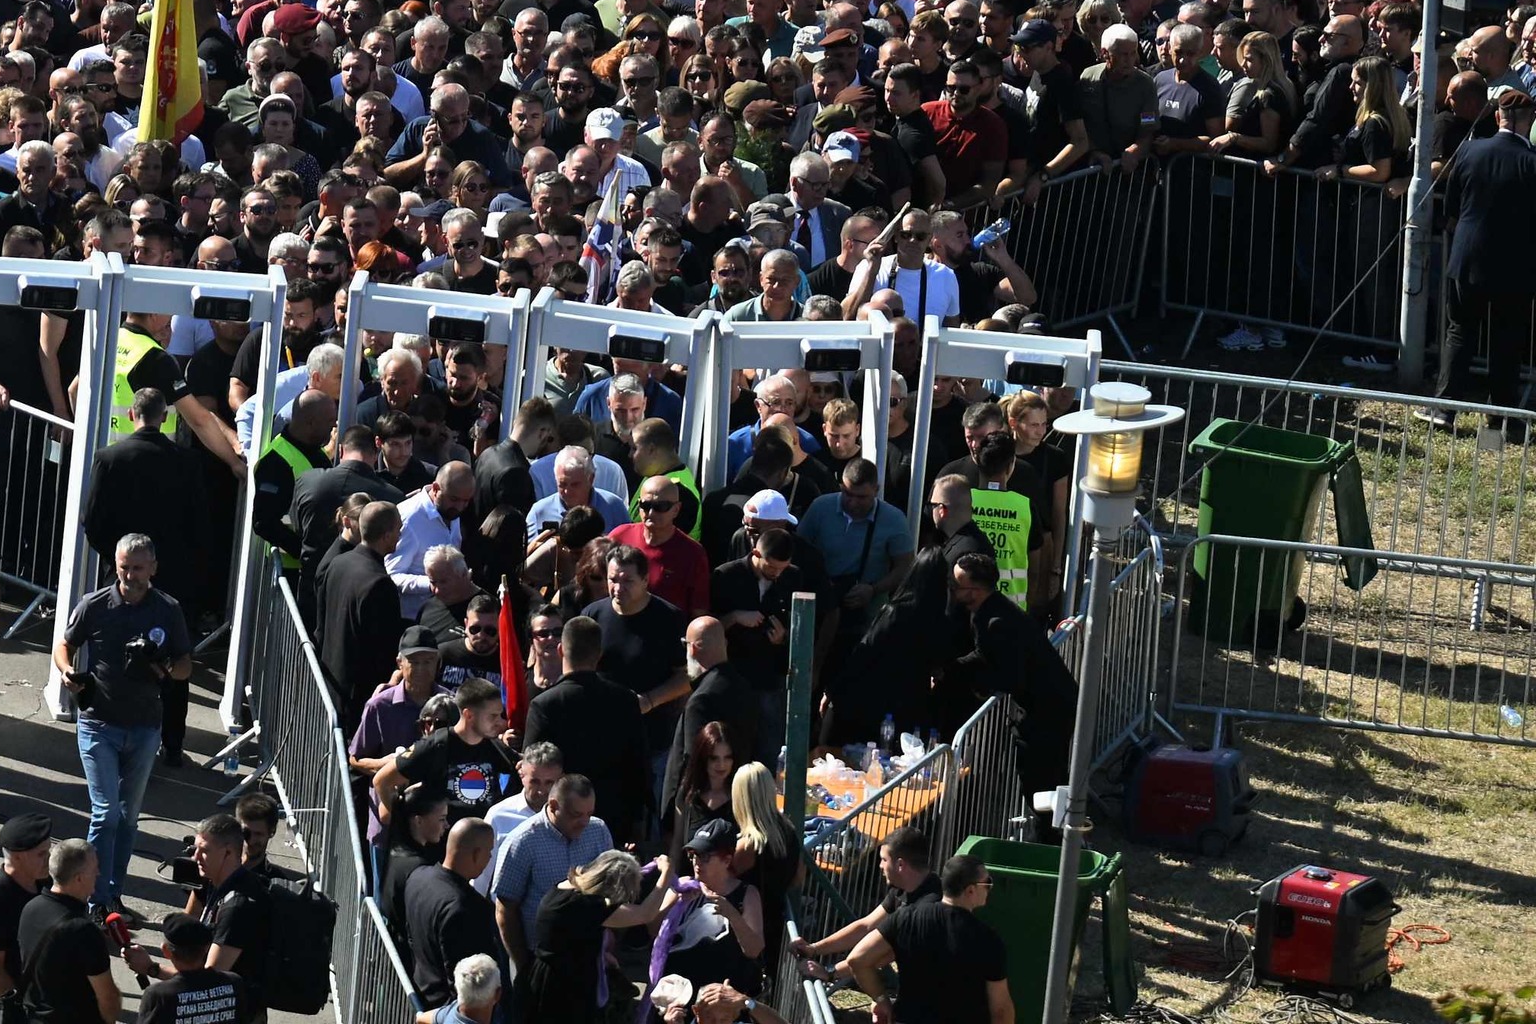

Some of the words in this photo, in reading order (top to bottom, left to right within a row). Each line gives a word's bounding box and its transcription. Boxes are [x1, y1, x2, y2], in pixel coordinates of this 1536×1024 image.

[1301, 915, 1332, 926] HONDA
[209, 984, 234, 998] ВЕТЕРАНА
[176, 1003, 197, 1016] ОРГАНА
